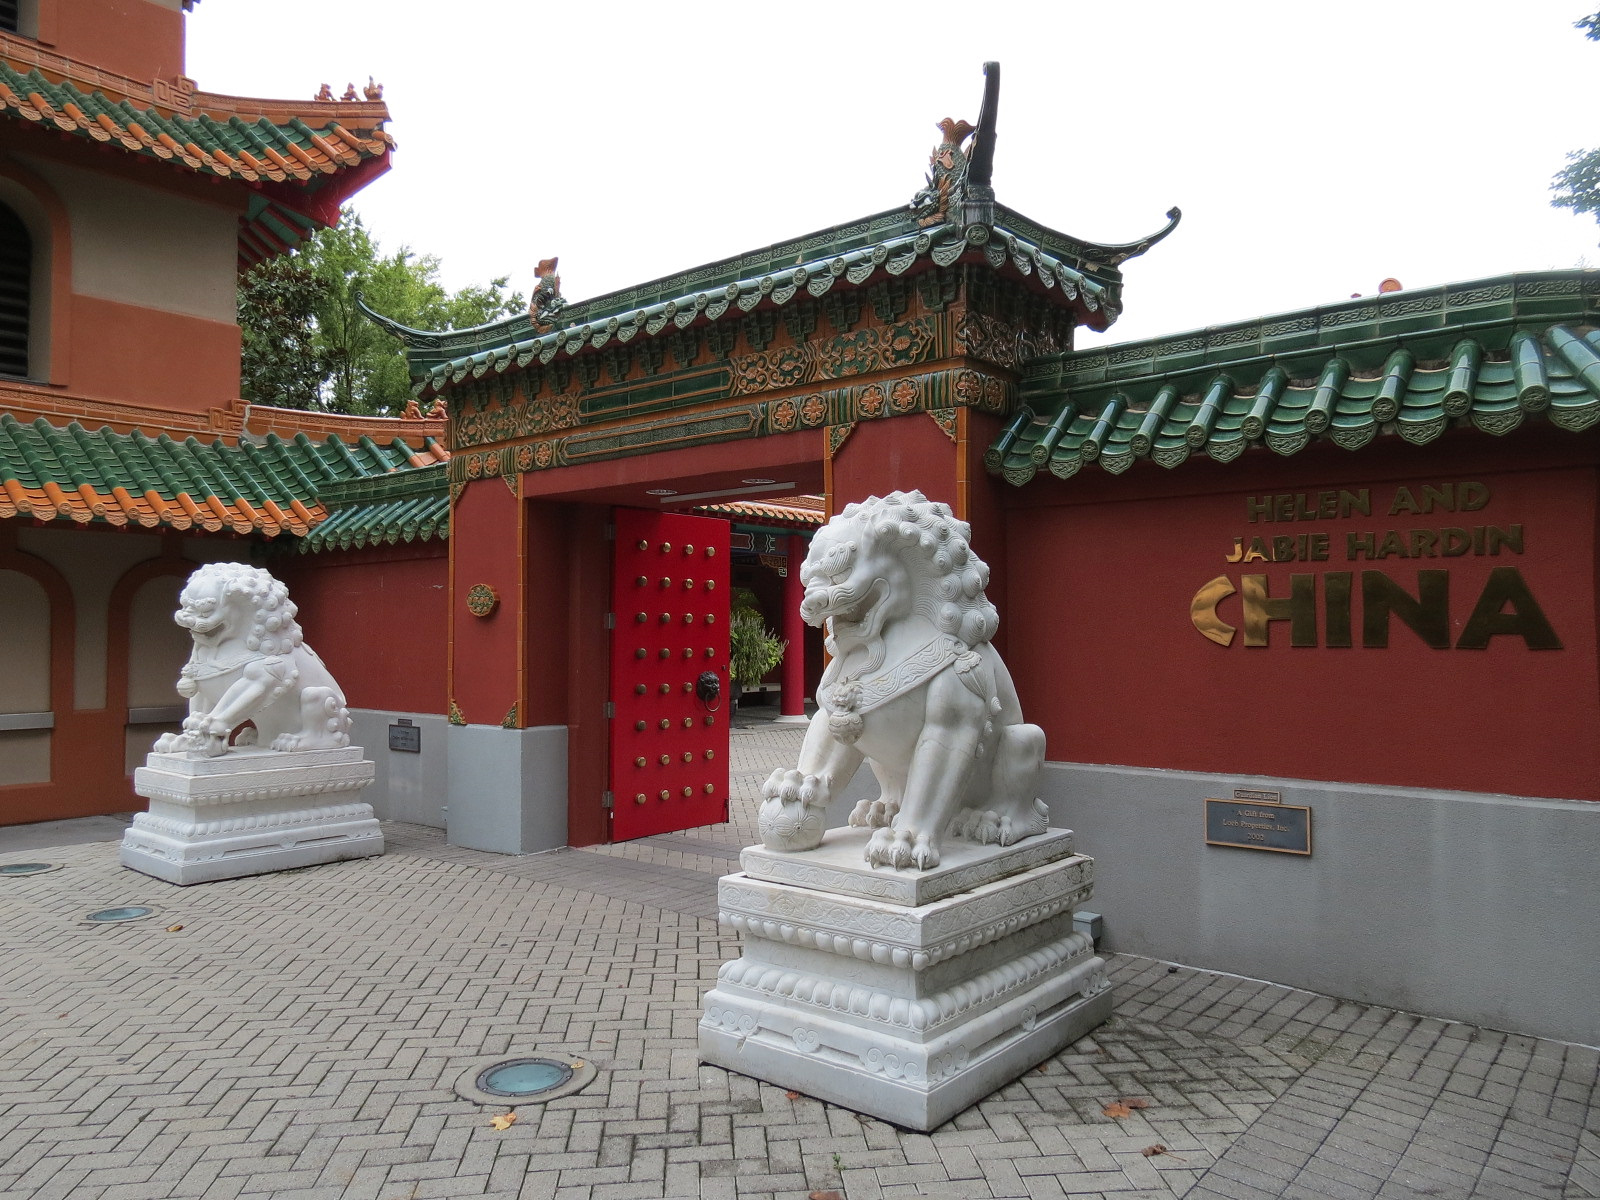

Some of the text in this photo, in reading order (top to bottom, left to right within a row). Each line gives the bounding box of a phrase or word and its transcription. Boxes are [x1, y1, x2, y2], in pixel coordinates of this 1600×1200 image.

[1247, 481, 1490, 523] HELEN AND
[1226, 524, 1524, 563] JABIE HARDIN
[1190, 566, 1564, 650] CHINA
[1259, 811, 1275, 819] from
[1247, 833, 1265, 841] 2002
